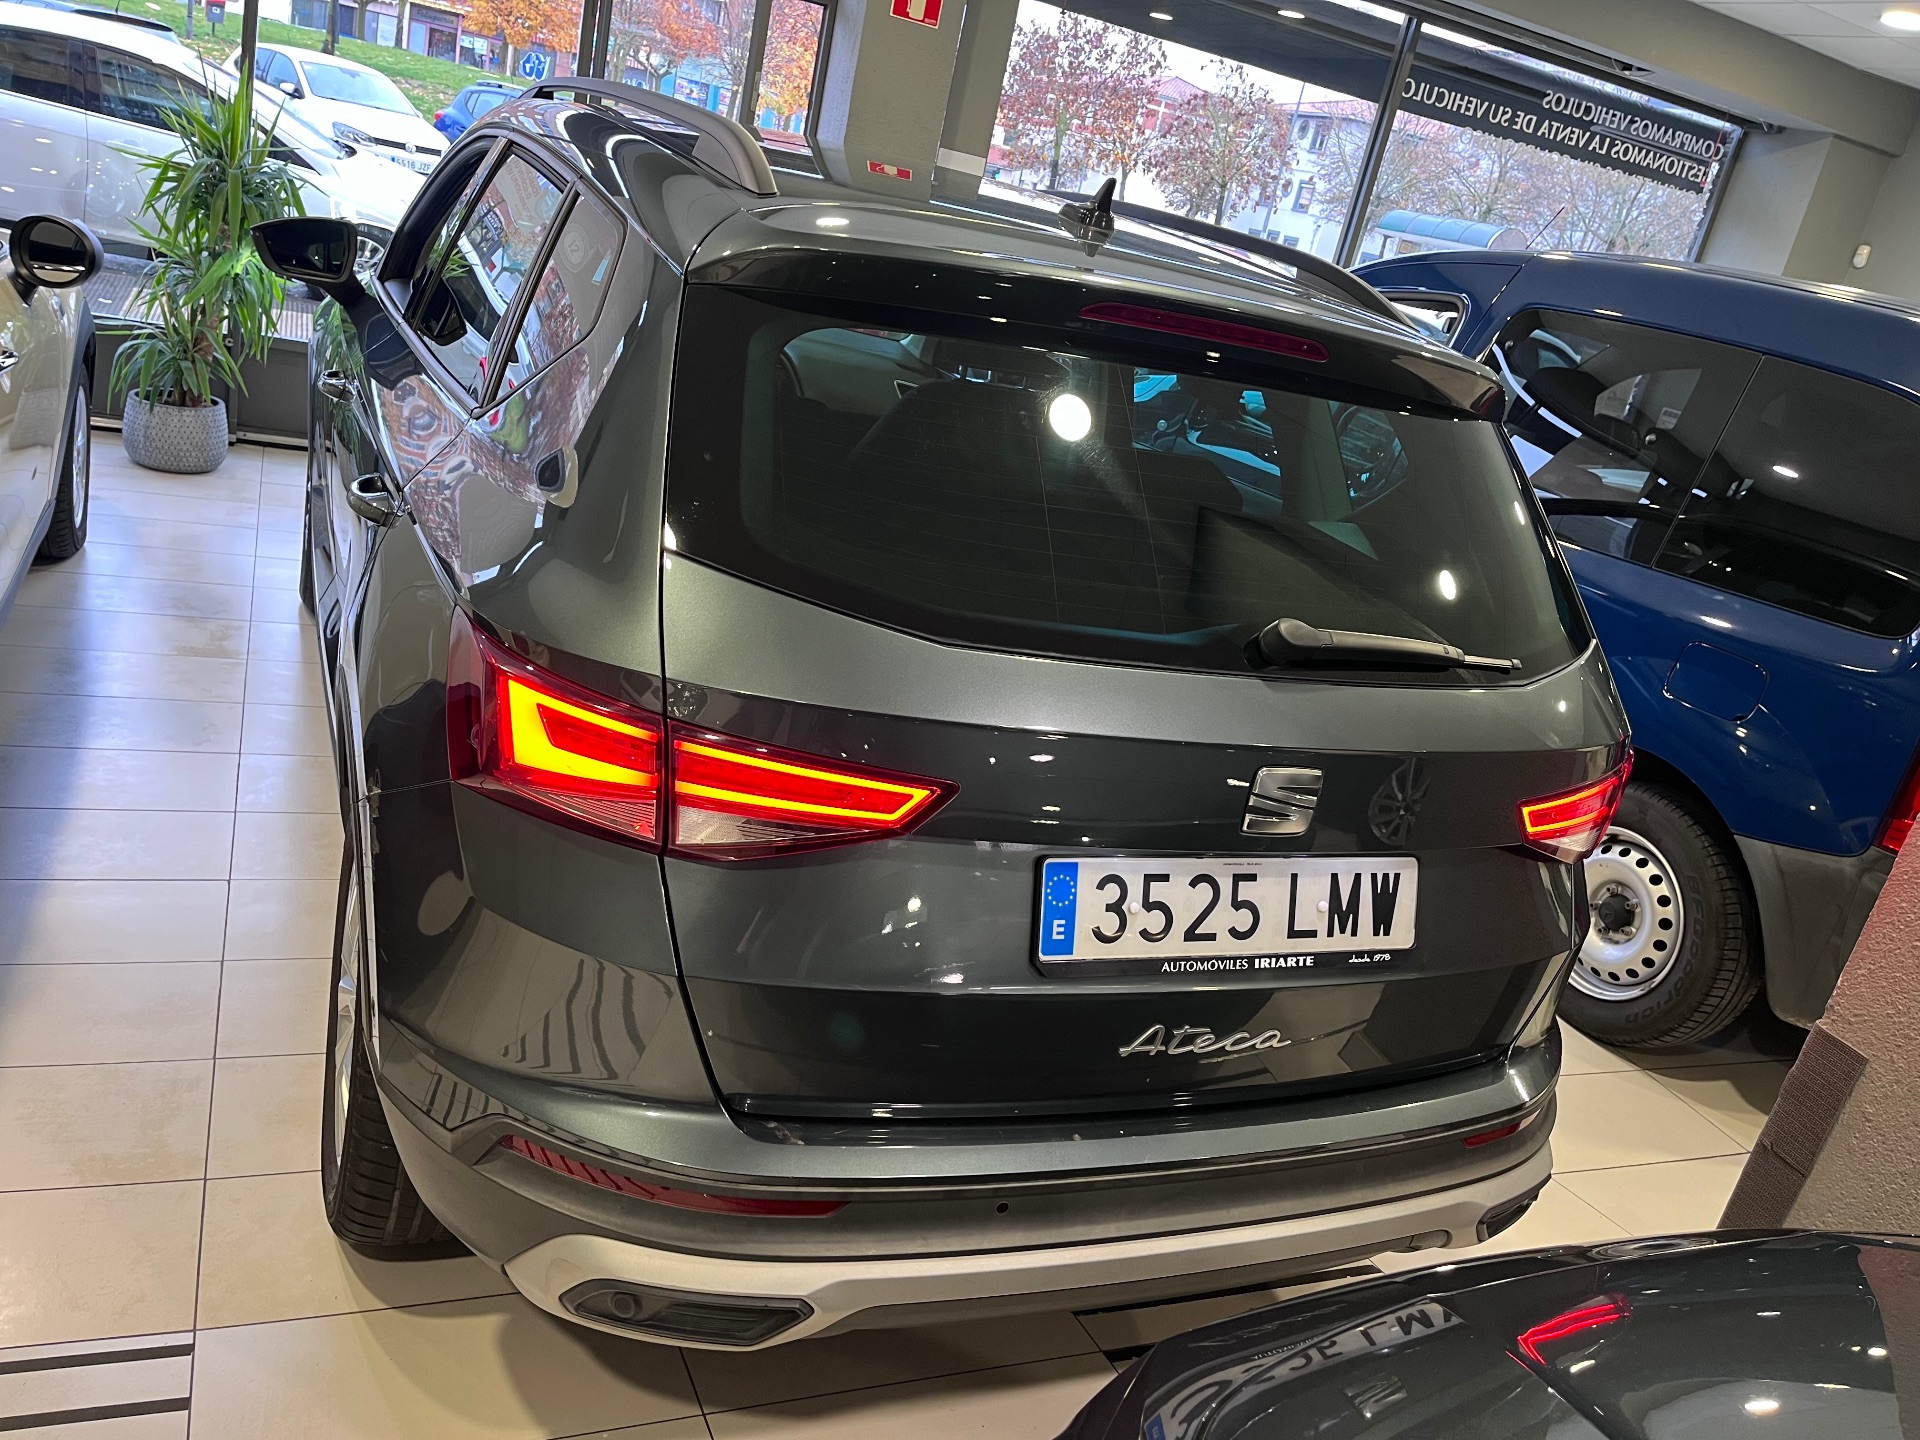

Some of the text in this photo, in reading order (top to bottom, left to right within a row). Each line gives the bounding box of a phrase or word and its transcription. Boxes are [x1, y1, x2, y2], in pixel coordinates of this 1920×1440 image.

[1092, 872, 1402, 944] 3525 LMW
[1052, 919, 1066, 940] E
[1161, 953, 1392, 973] AUTOMÓVILES IRIARTE desde 1978
[1118, 1023, 1292, 1057] Ateca
